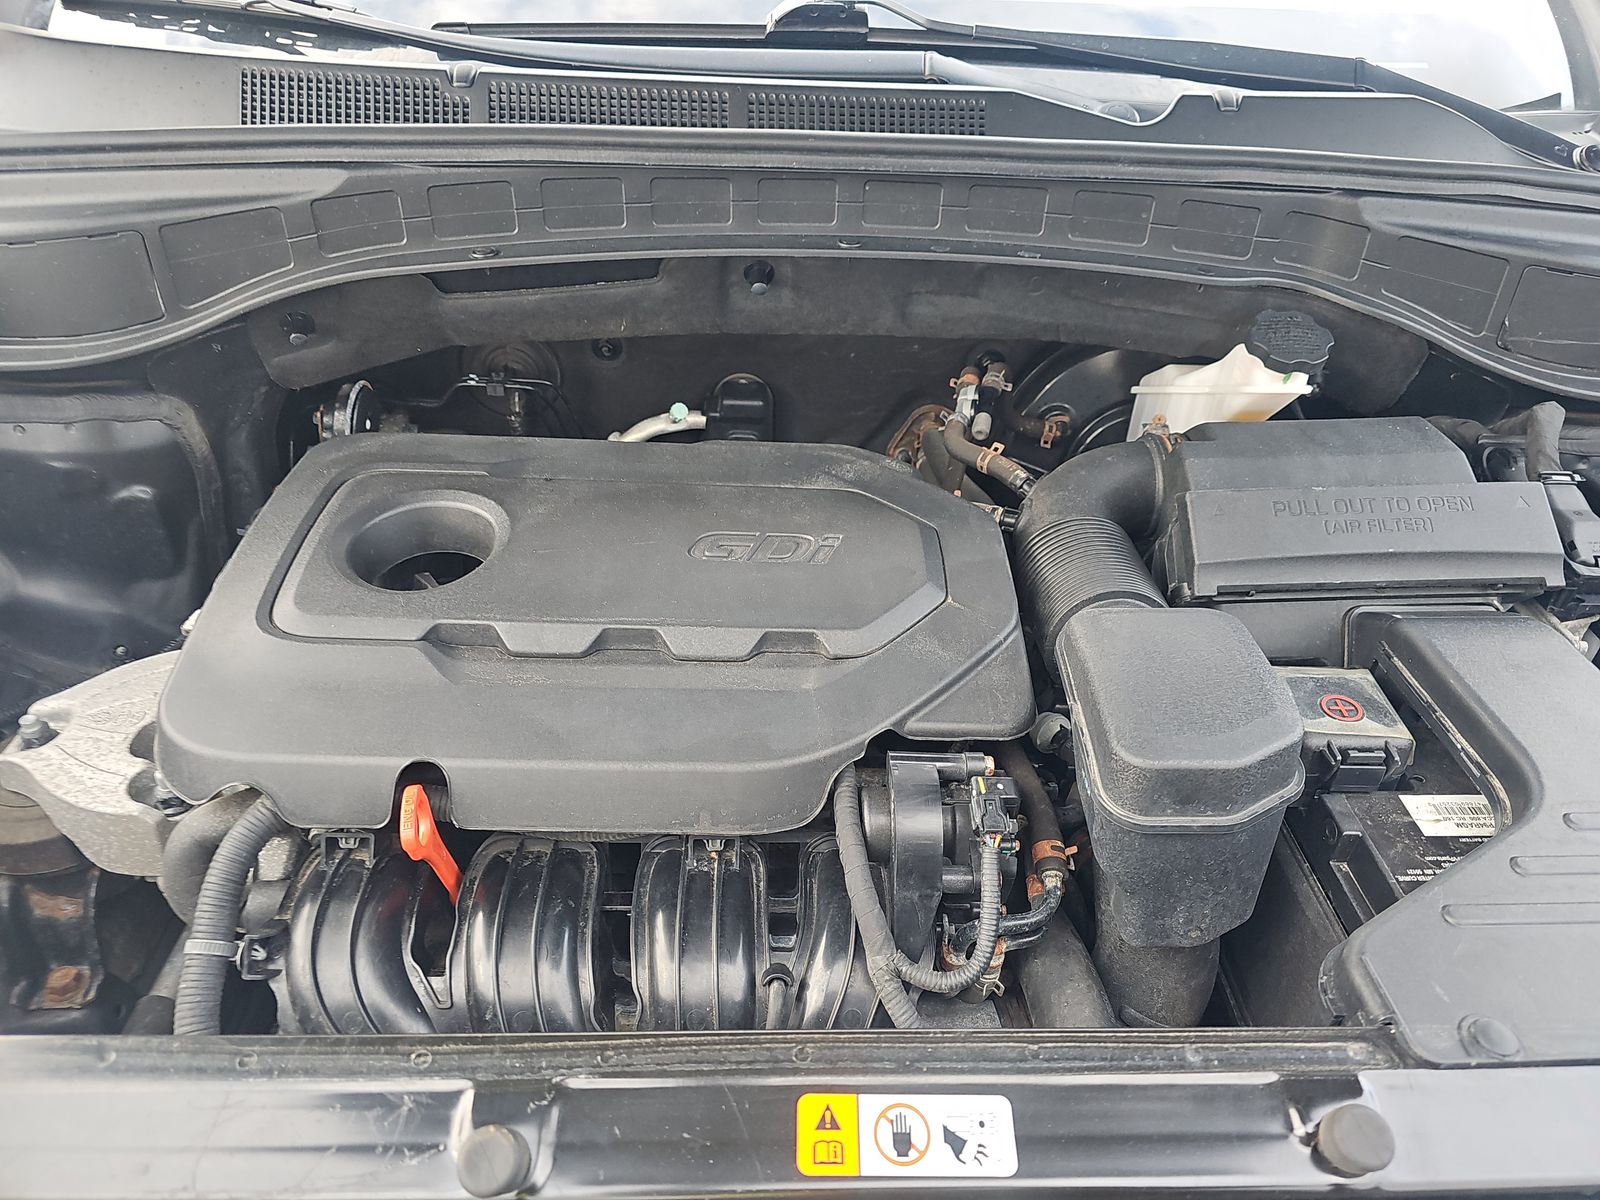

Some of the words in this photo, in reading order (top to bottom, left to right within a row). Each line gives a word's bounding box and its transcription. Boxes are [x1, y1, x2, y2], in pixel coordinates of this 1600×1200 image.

[1271, 499, 1328, 517] PULL
[1333, 498, 1376, 516] OUT
[1384, 497, 1414, 514] TO
[1417, 495, 1475, 513] OPEN
[1323, 518, 1363, 536] (AIR
[1367, 516, 1435, 534] FILTER)
[687, 530, 844, 565] GDi
